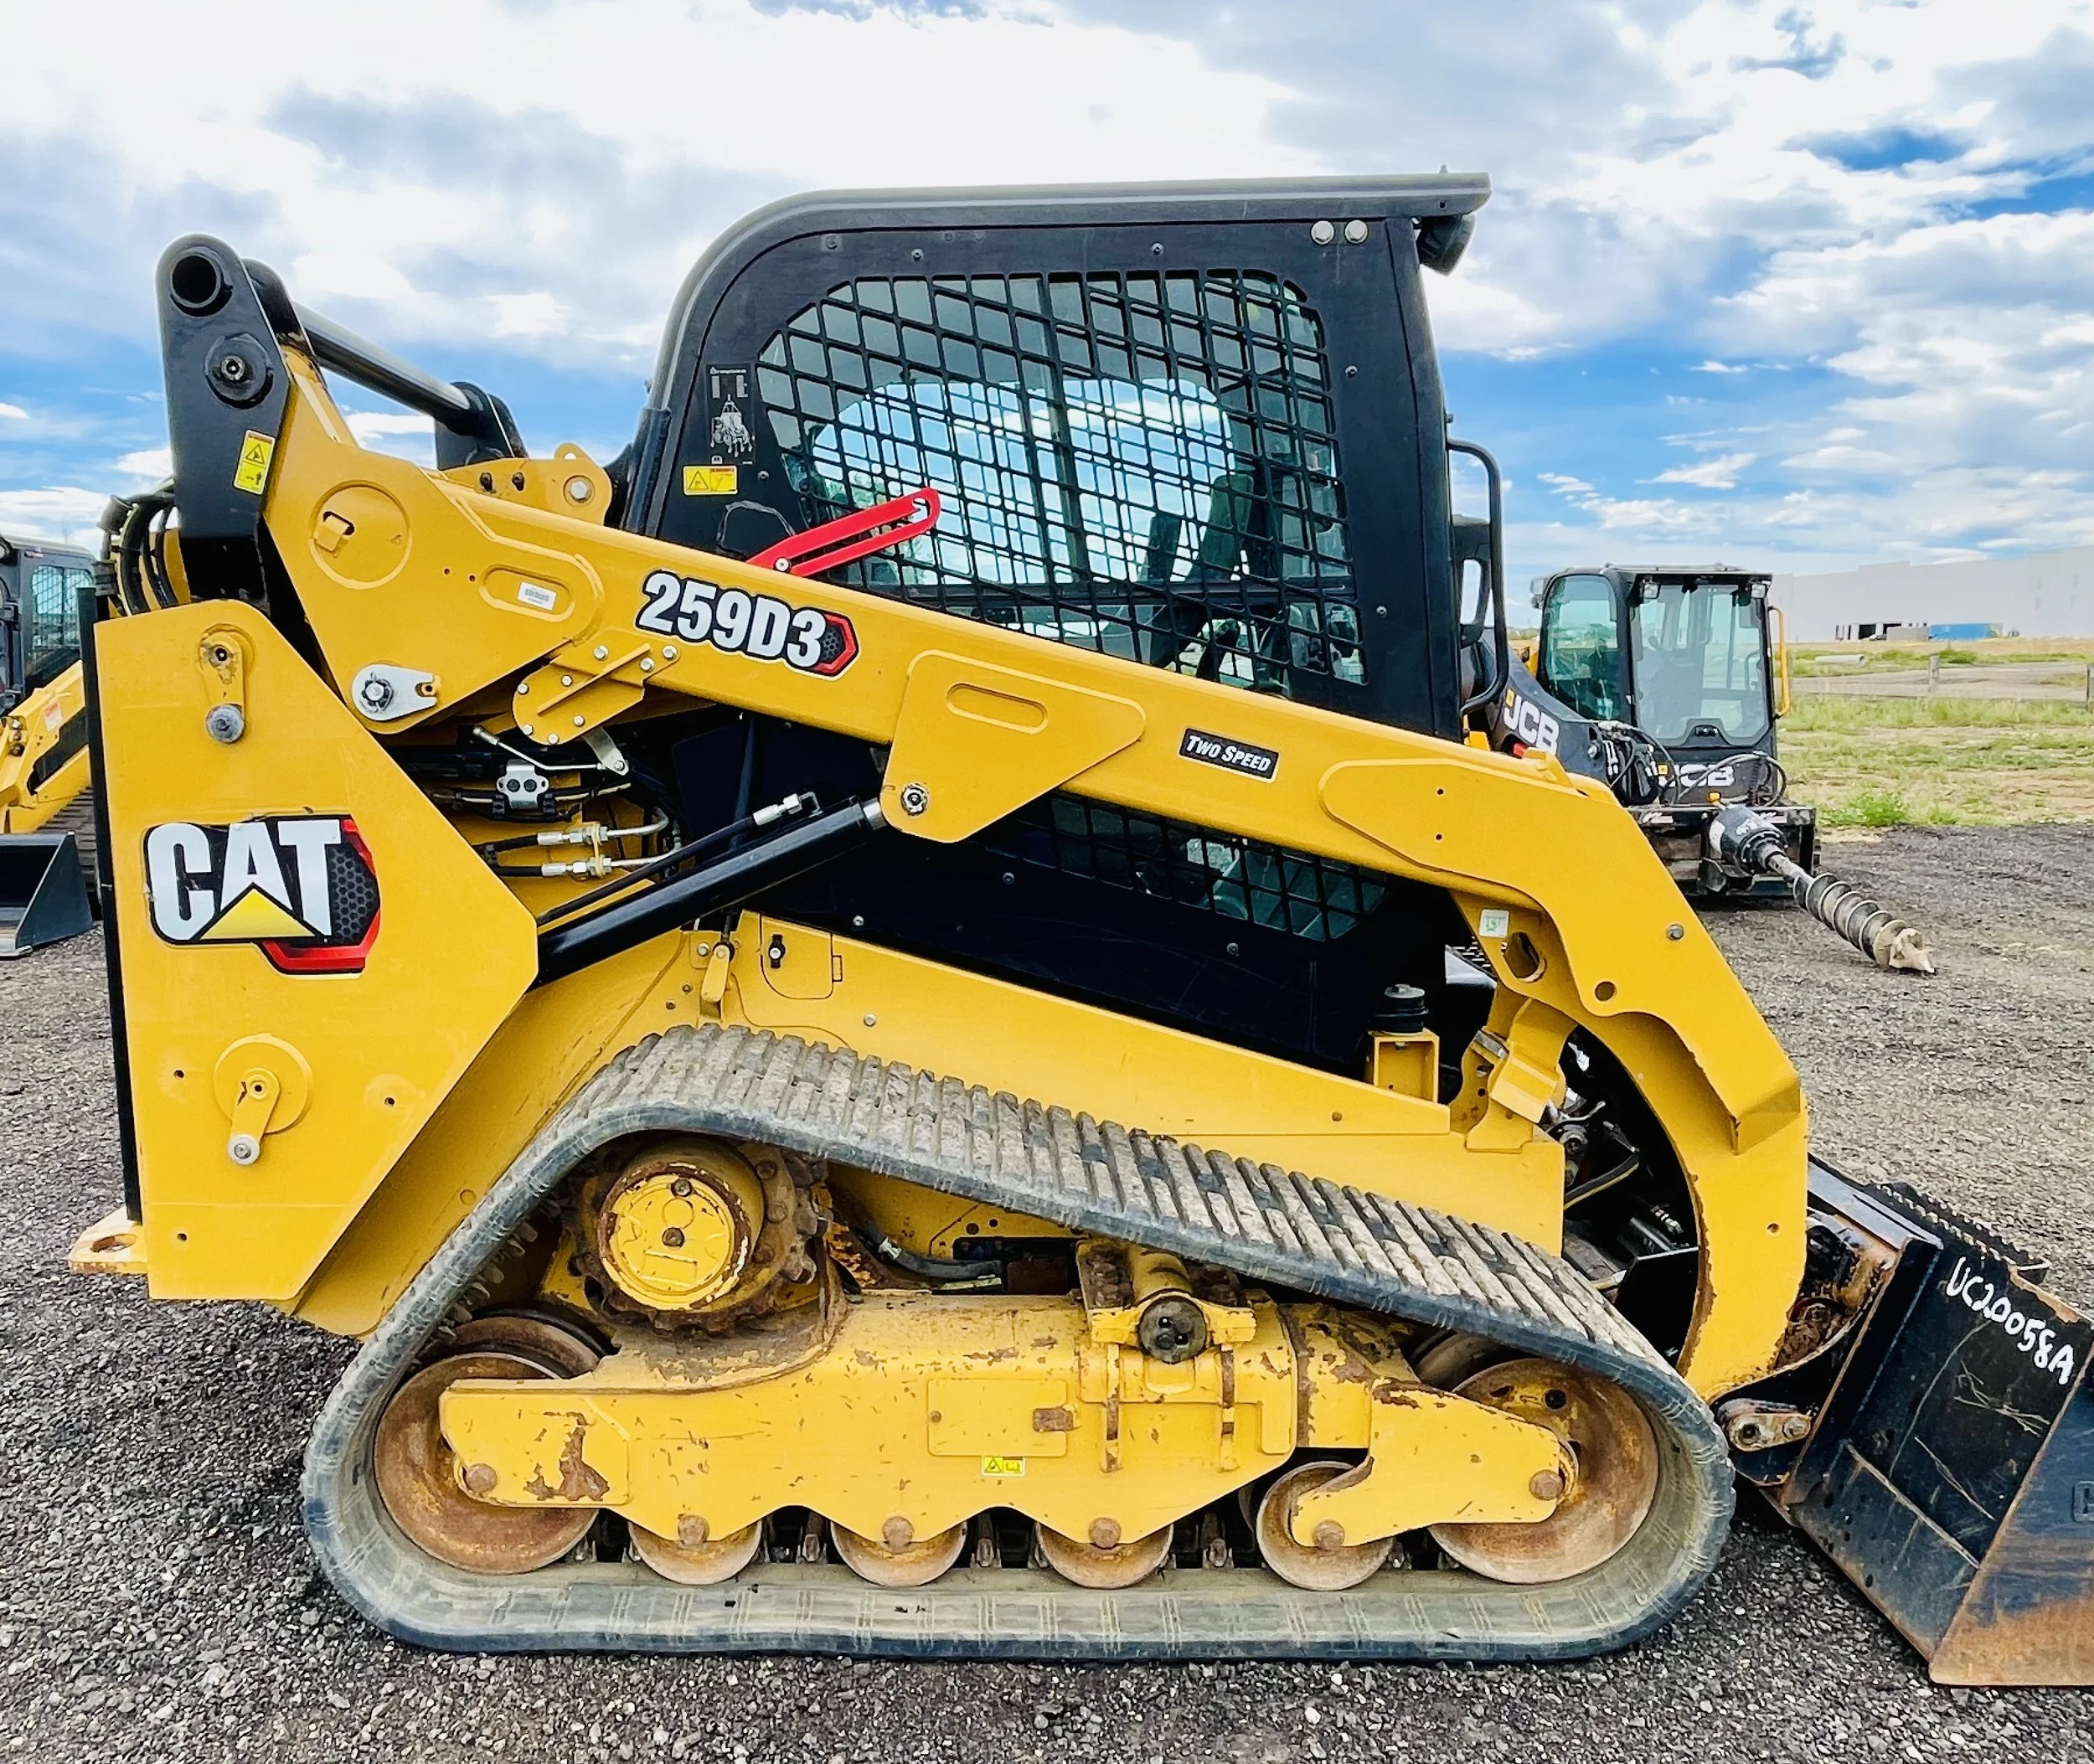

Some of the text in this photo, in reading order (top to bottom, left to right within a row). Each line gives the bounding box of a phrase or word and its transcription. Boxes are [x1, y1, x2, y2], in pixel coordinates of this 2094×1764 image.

[638, 573, 826, 668] 259D3
[1503, 689, 1560, 756] JCB
[147, 819, 341, 941] CAT
[1946, 1256, 2075, 1385] UC20058A
